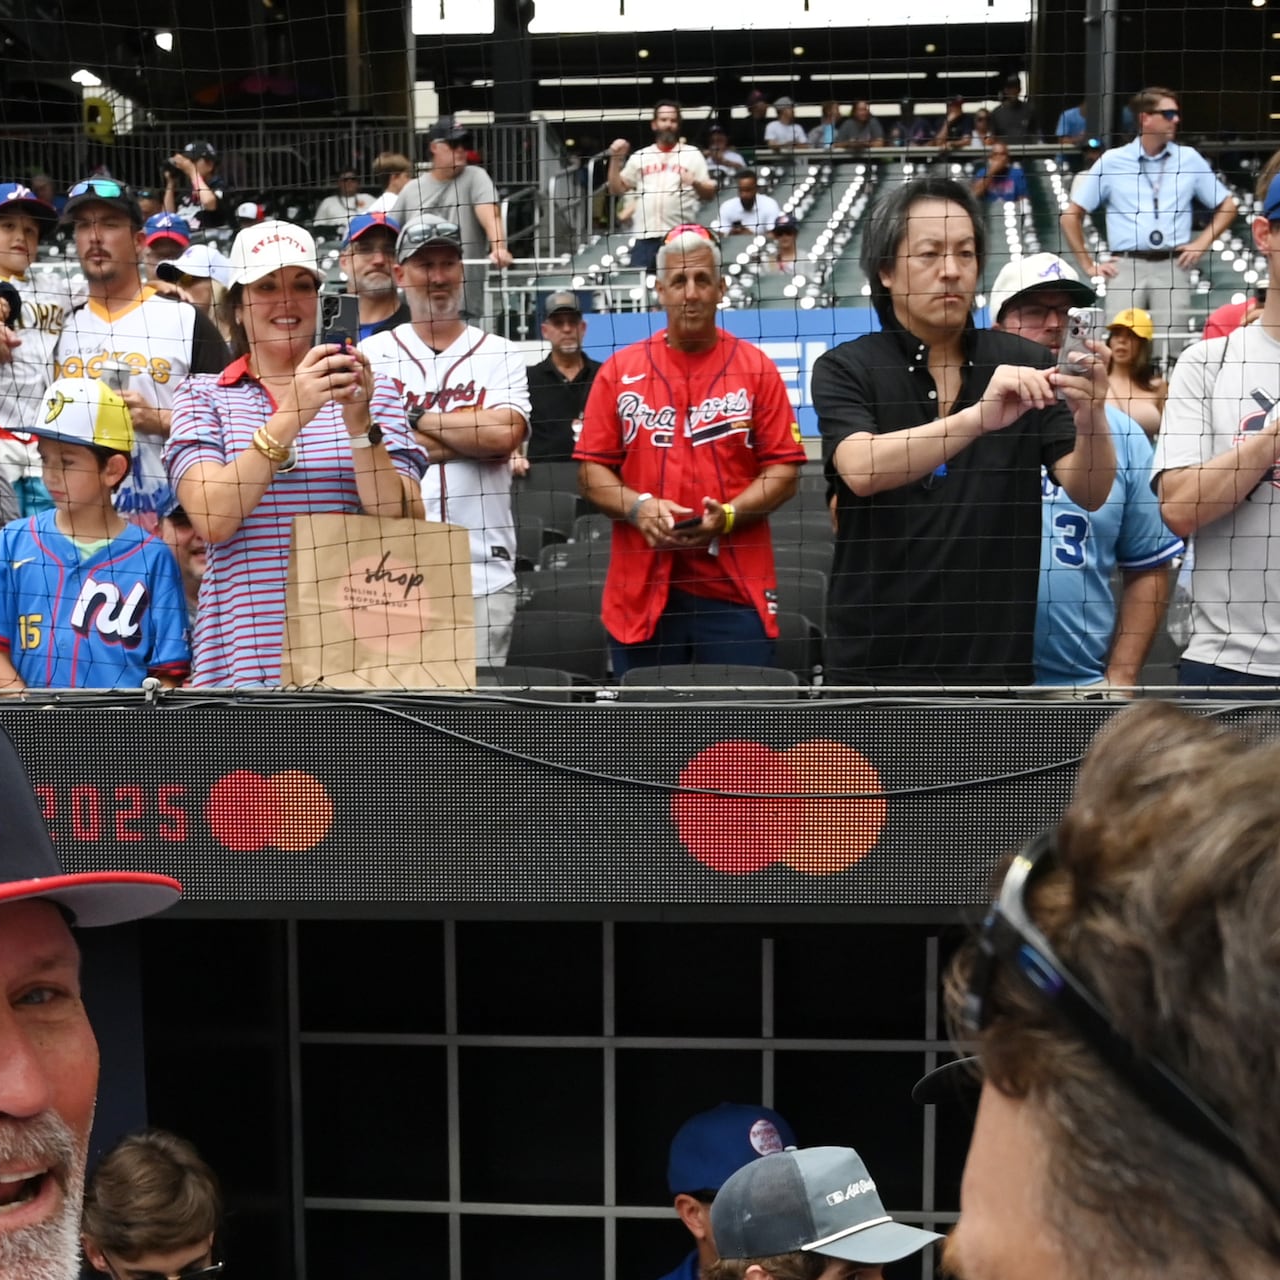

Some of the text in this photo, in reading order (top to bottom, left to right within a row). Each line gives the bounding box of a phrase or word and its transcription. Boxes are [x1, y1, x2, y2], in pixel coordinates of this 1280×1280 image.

[392, 378, 475, 413] raves
[1053, 510, 1089, 569] 3
[365, 550, 424, 599] shop
[18, 614, 43, 650] 15
